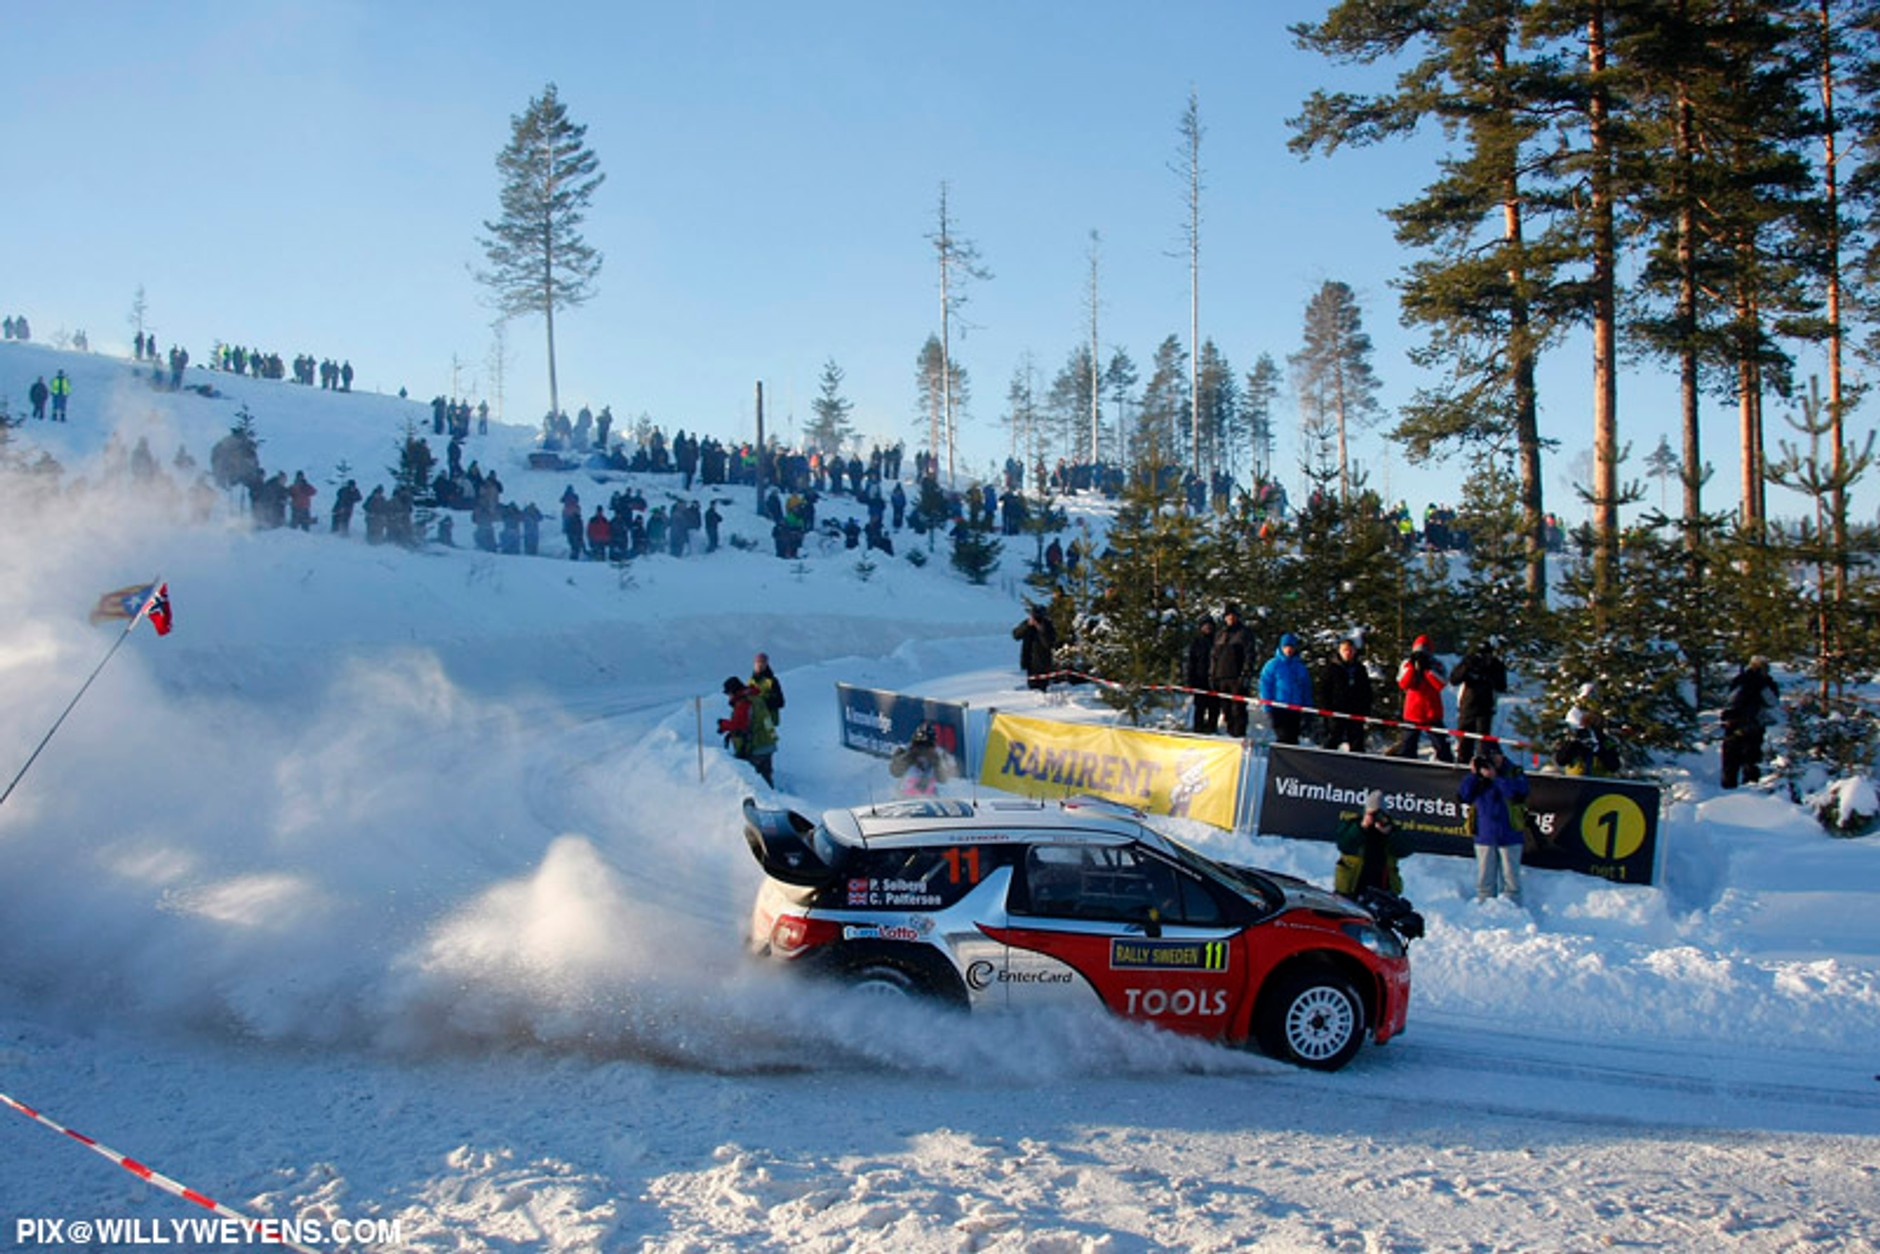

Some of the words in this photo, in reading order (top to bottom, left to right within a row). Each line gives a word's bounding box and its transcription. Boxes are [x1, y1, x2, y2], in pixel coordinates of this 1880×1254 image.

[1000, 741, 1161, 798] RAMIRENT
[1275, 776, 1370, 806] Värmland
[1383, 792, 1457, 818] största
[1597, 810, 1619, 859] 1
[941, 847, 980, 884] 11
[1617, 865, 1626, 879] 1
[869, 879, 880, 892] P.
[883, 878, 928, 894] Solberg
[869, 893, 882, 906] C.
[885, 892, 942, 906] Patterson
[1115, 944, 1149, 963] RALLY
[1152, 946, 1199, 964] SWEDEN
[1204, 941, 1223, 969] 11
[996, 969, 1073, 984] EnterCard
[1124, 987, 1228, 1016] TOOLS
